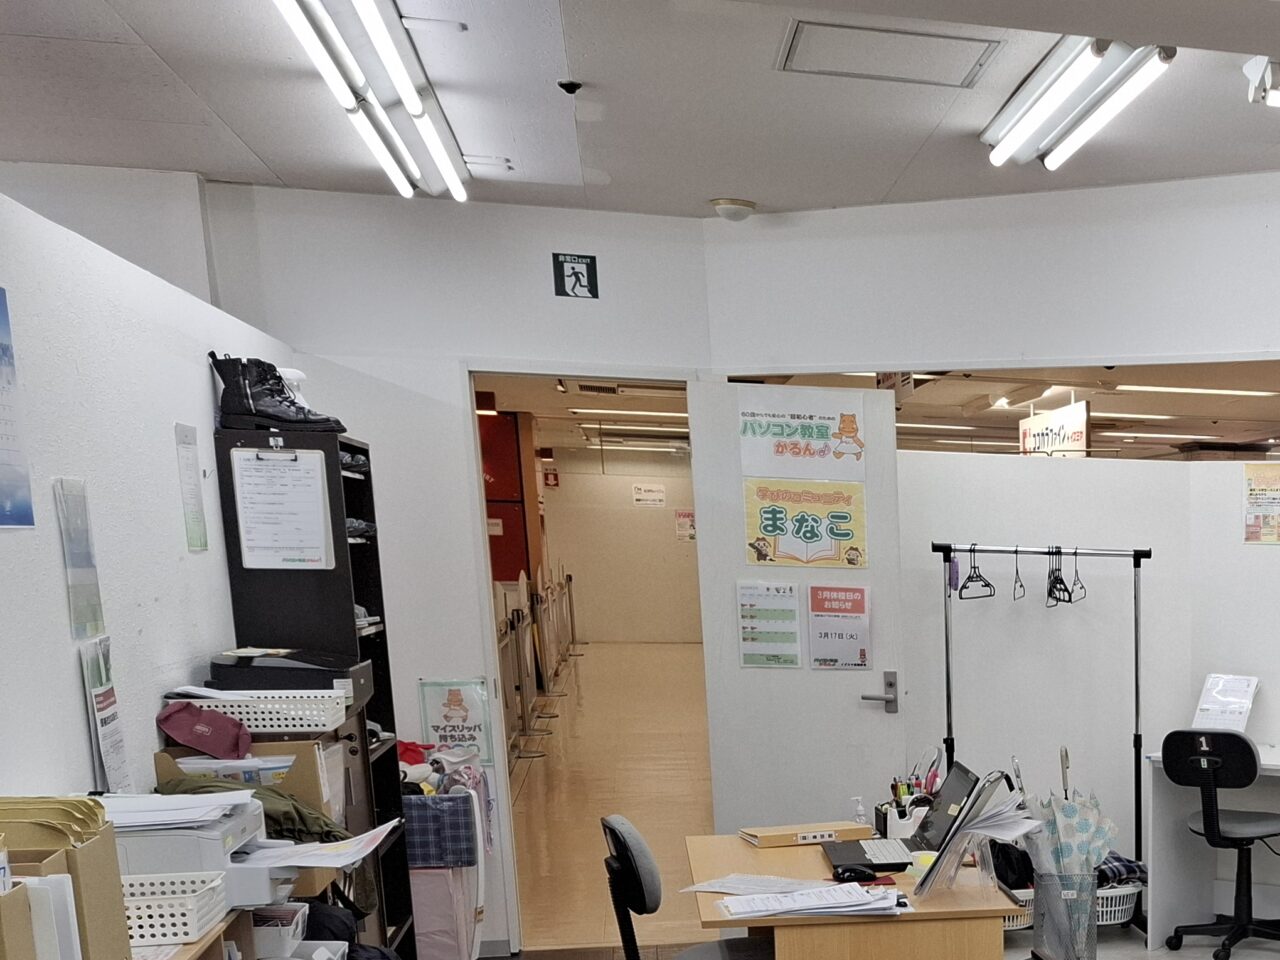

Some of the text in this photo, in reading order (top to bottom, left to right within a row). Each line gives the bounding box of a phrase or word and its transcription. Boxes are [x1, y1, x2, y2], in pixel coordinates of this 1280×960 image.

[741, 422, 830, 439] パソコン教室
[757, 487, 853, 506] 学びのコミュニティ
[760, 506, 854, 543] まなこ
[824, 601, 853, 609] お知らせ
[431, 723, 482, 734] マイスリッパ
[438, 733, 477, 744] 持ち込み
[1200, 736, 1210, 751] 1
